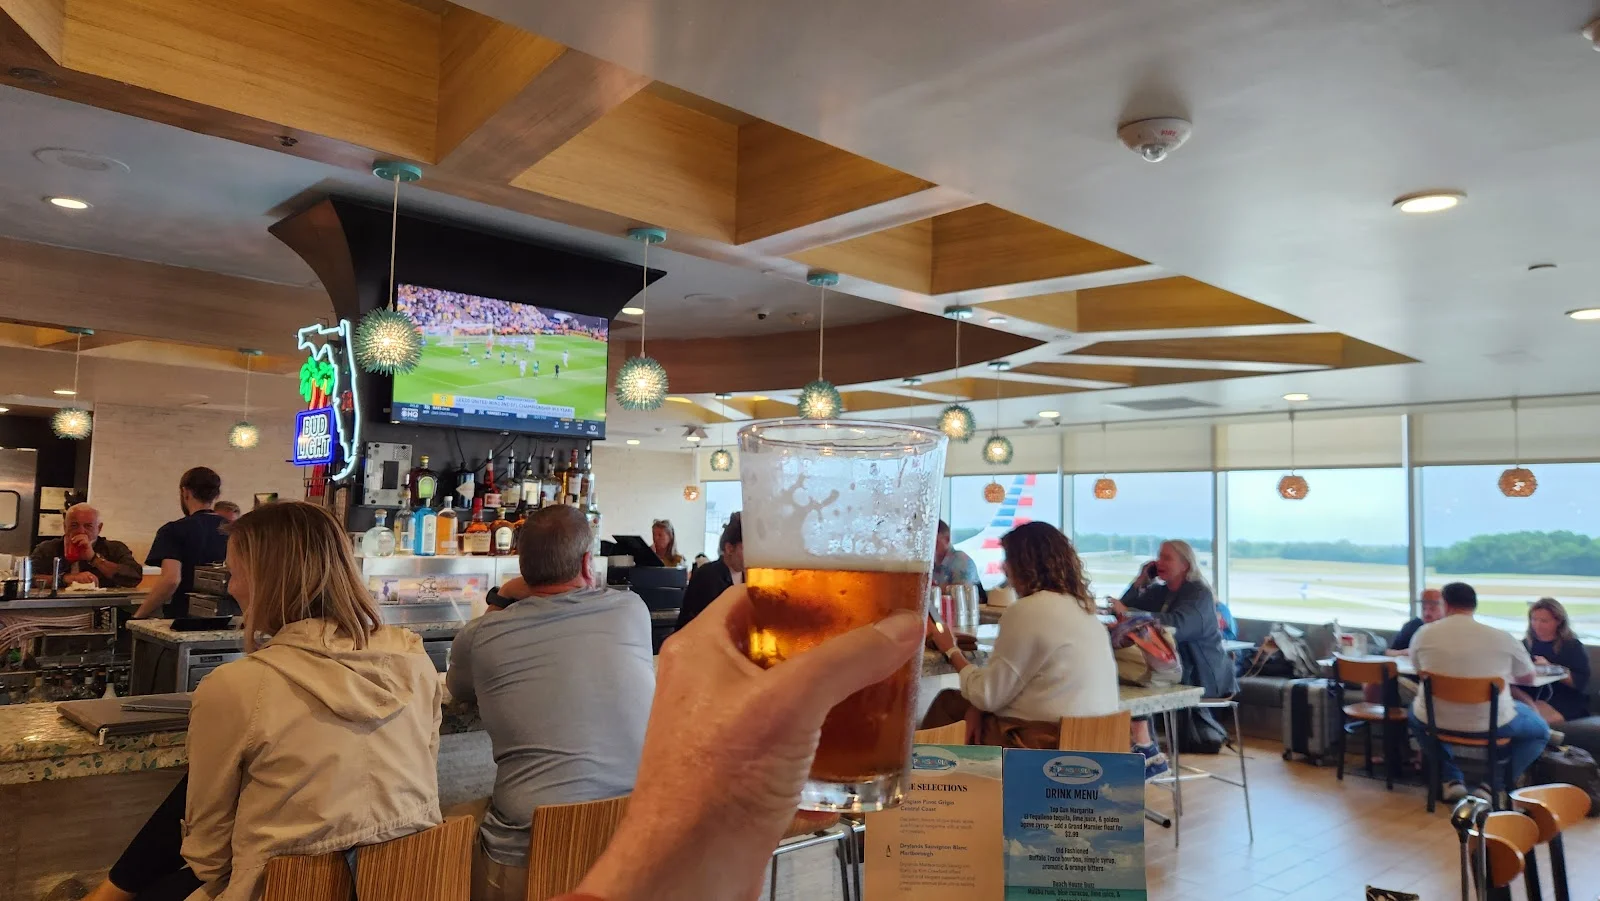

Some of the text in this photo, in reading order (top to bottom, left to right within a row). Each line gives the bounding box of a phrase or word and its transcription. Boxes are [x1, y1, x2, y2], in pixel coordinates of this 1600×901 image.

[303, 414, 328, 437] BUD
[297, 434, 331, 459] LIGHT
[917, 784, 968, 792] SELECTIONS
[1045, 788, 1099, 800] DRINK MENU
[1050, 806, 1059, 814] Top
[1069, 807, 1094, 815] Margarita
[1053, 814, 1072, 822] tequila,
[1083, 823, 1103, 831] Marnier
[1084, 856, 1101, 864] simple
[1087, 864, 1104, 872] bitters
[1053, 880, 1068, 888] Beach
